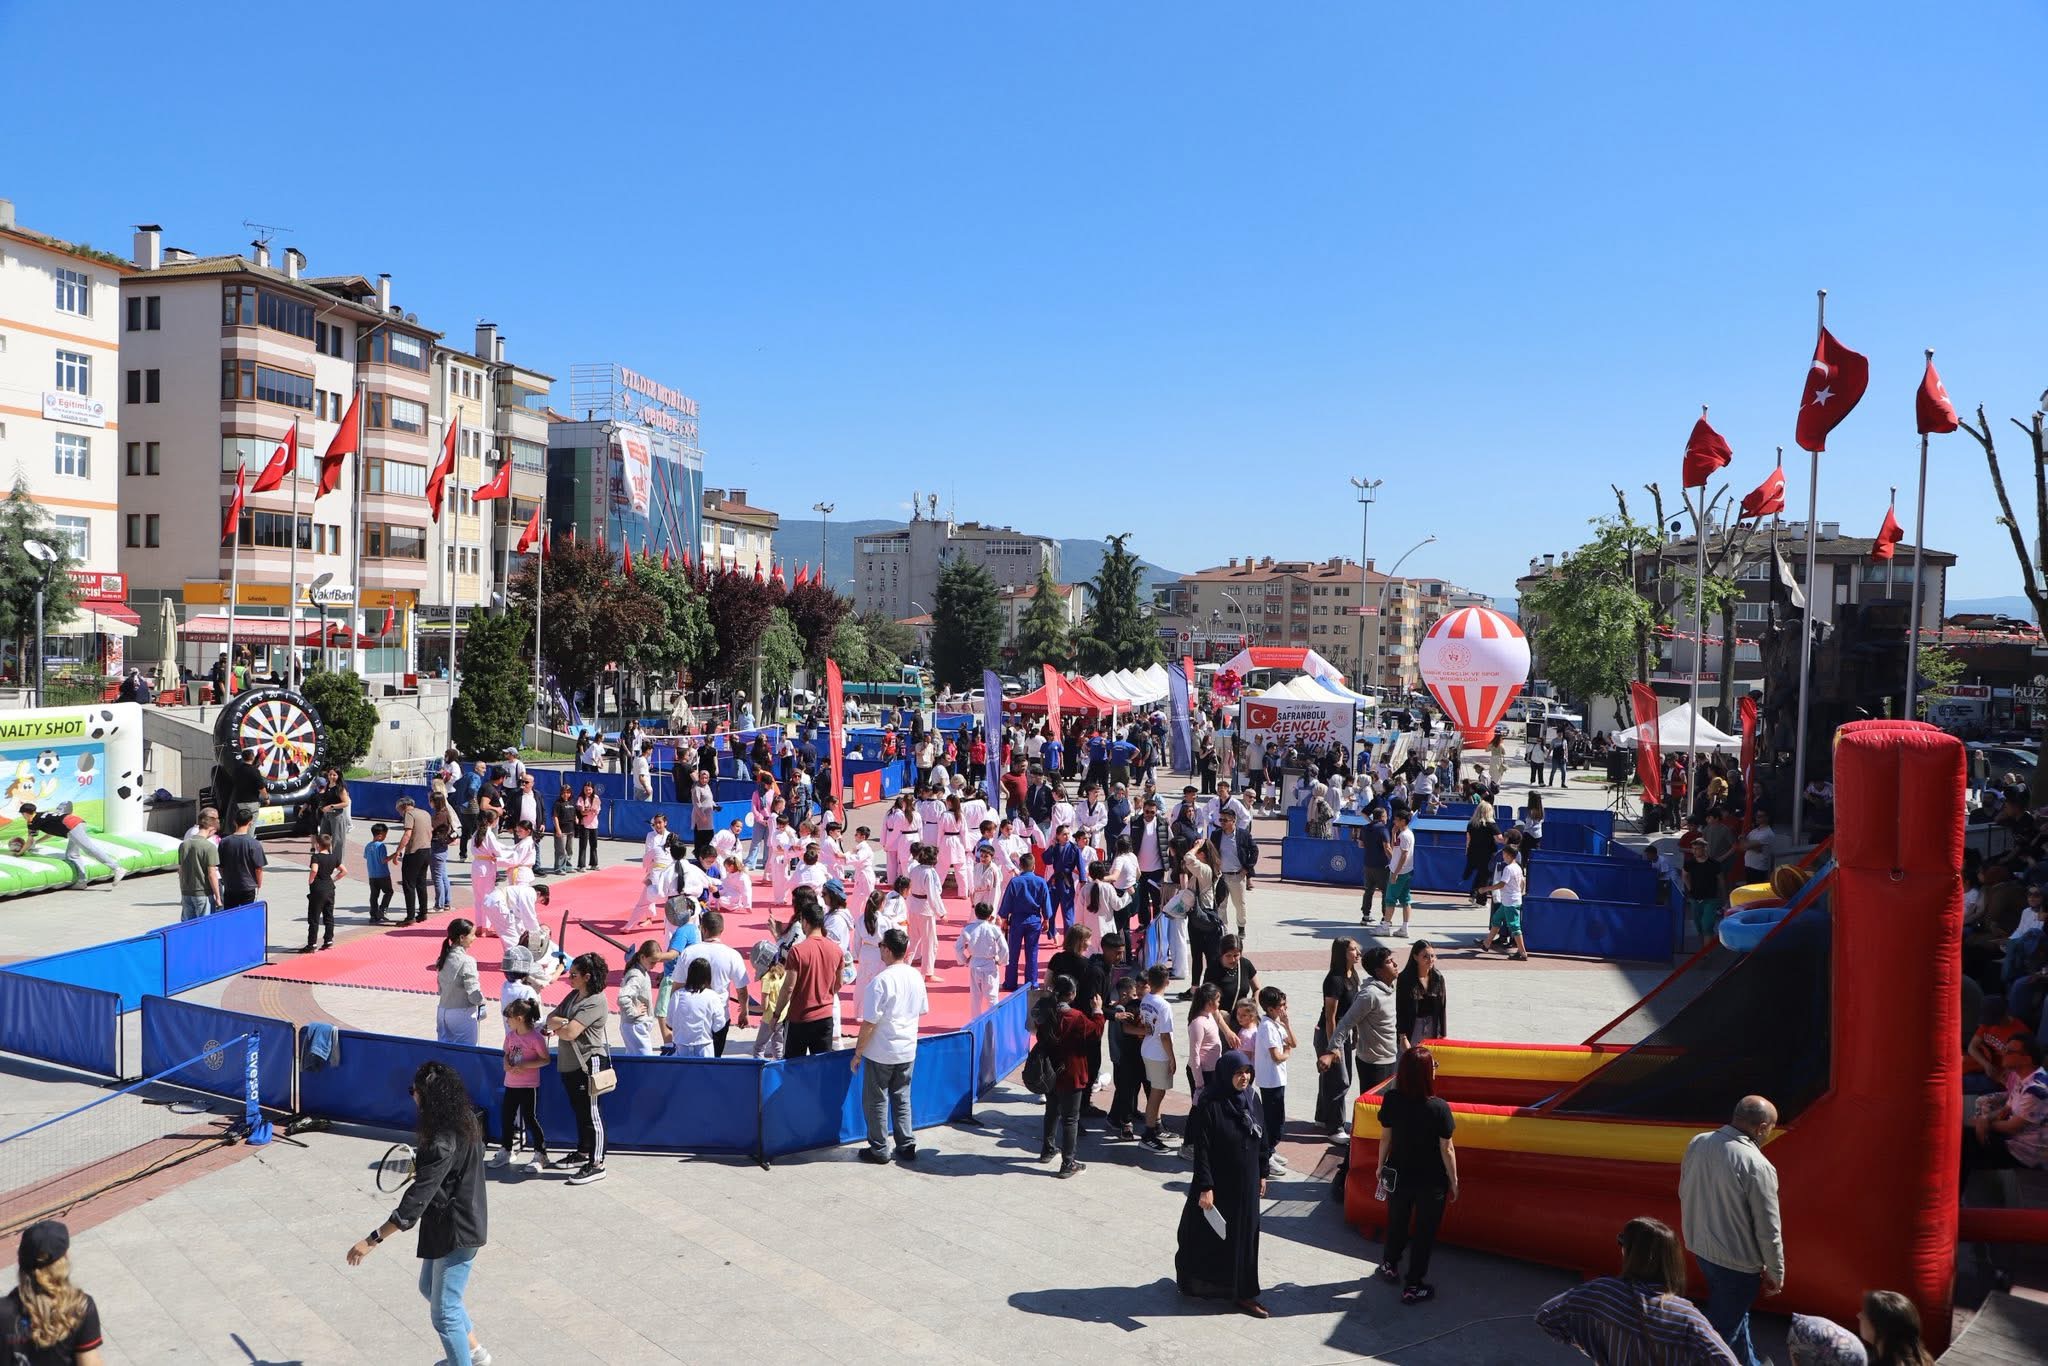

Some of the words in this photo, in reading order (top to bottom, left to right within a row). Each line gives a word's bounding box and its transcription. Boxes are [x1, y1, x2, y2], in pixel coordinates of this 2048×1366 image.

[312, 588, 353, 601] VakıfBan
[1277, 711, 1326, 721] SAFRANBOLU
[45, 720, 83, 735] SHOT
[1294, 732, 1326, 743] SPOR
[77, 775, 93, 787] 90
